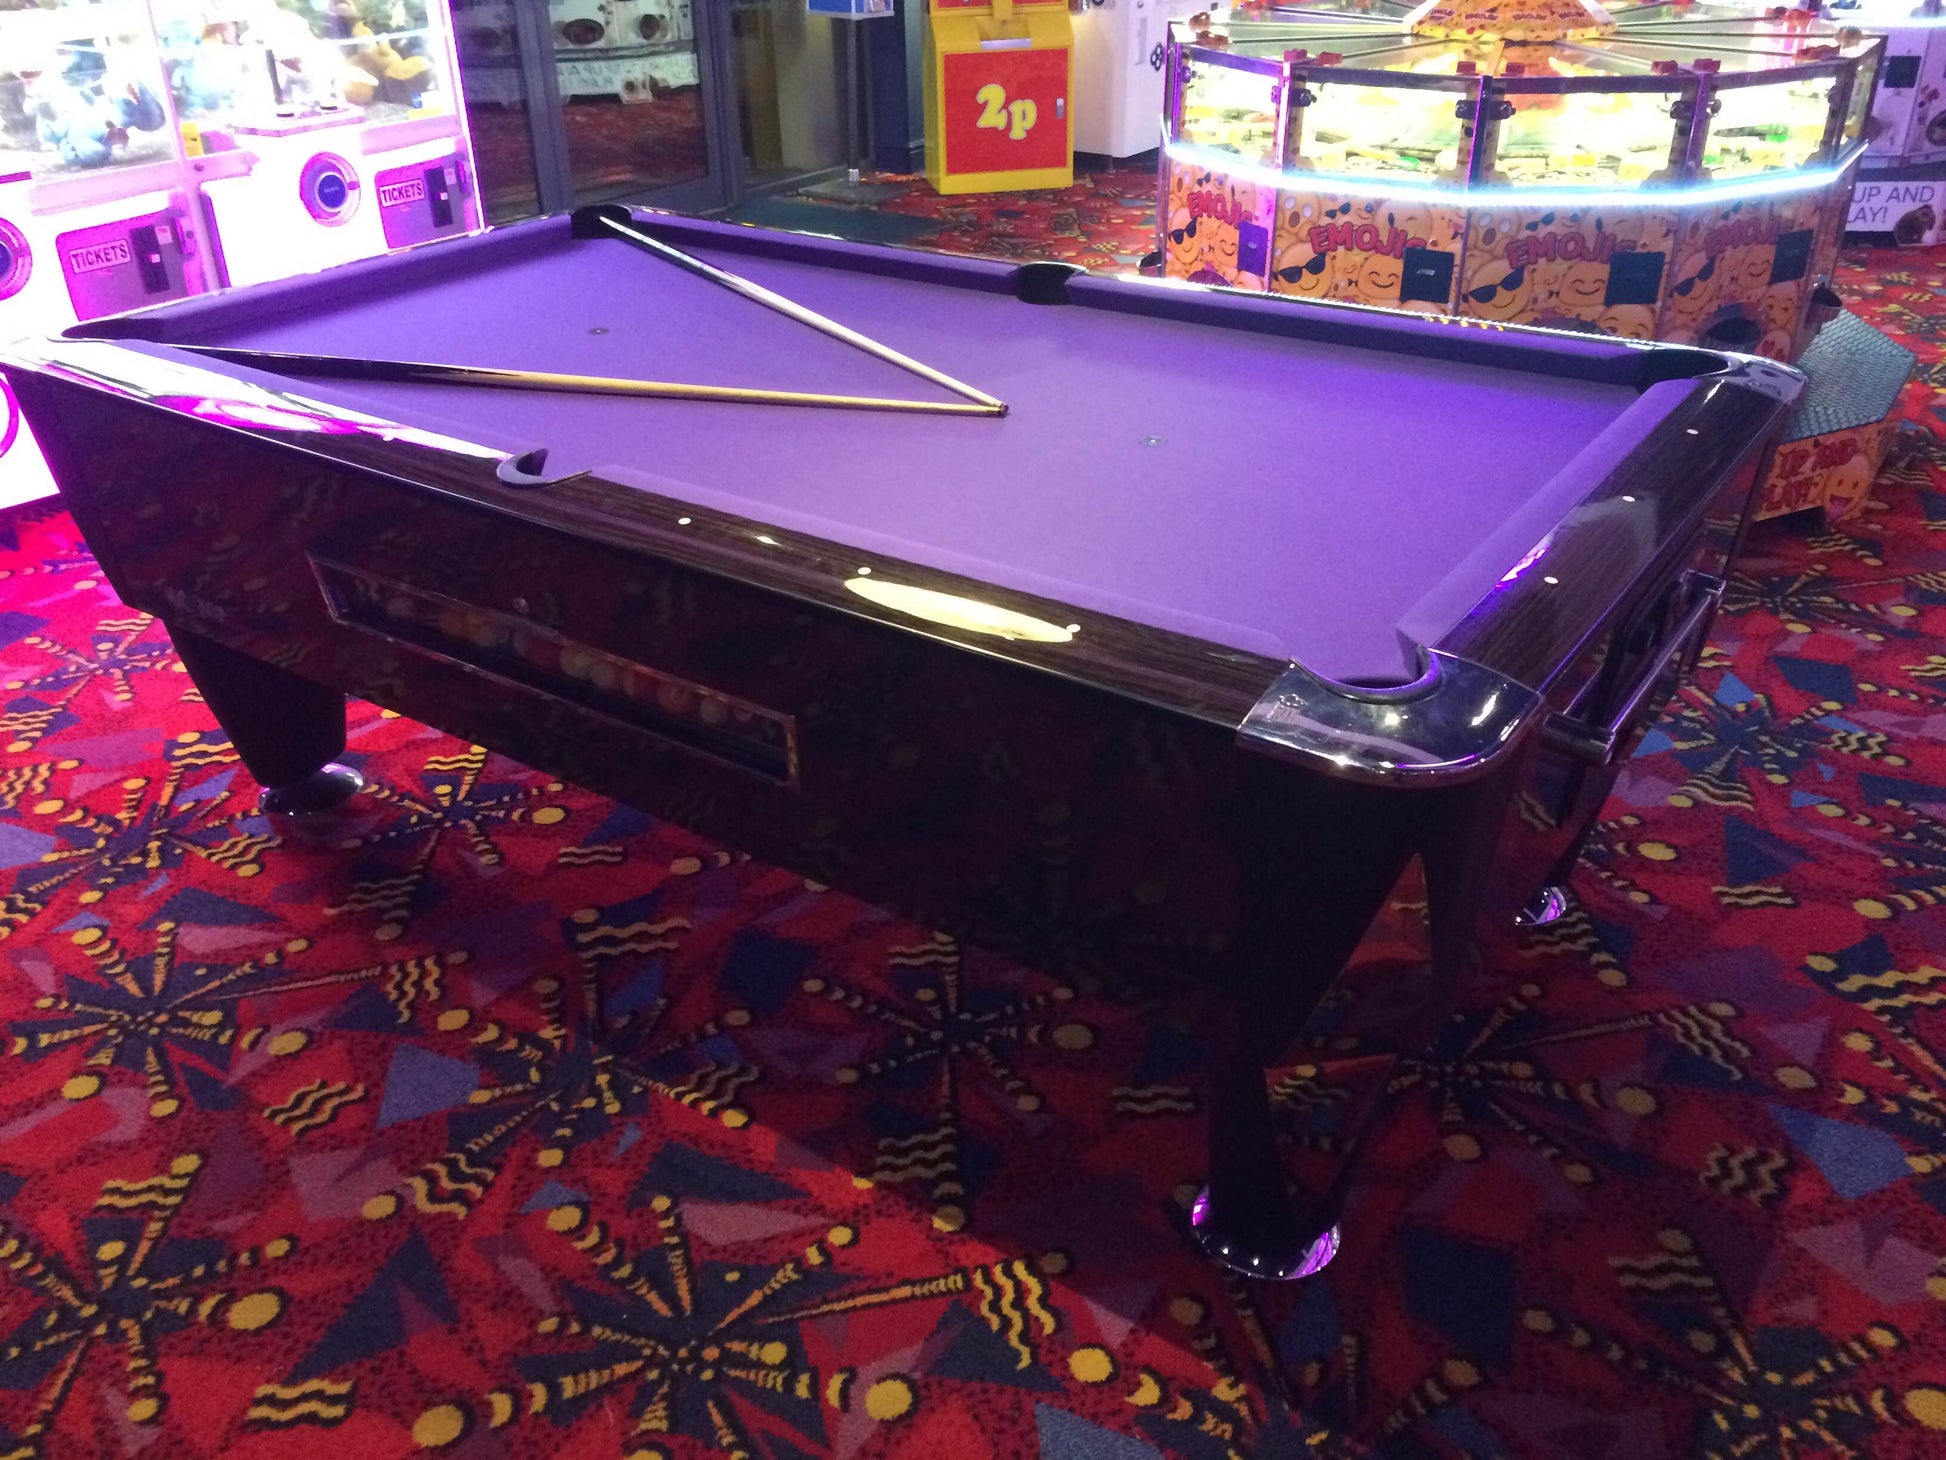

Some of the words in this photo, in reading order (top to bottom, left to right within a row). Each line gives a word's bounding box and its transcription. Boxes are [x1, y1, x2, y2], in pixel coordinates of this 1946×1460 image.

[976, 84, 1037, 140] 2p
[381, 182, 423, 204] TICKETS
[1885, 185, 1935, 203] AND
[71, 243, 129, 270] TICKETS
